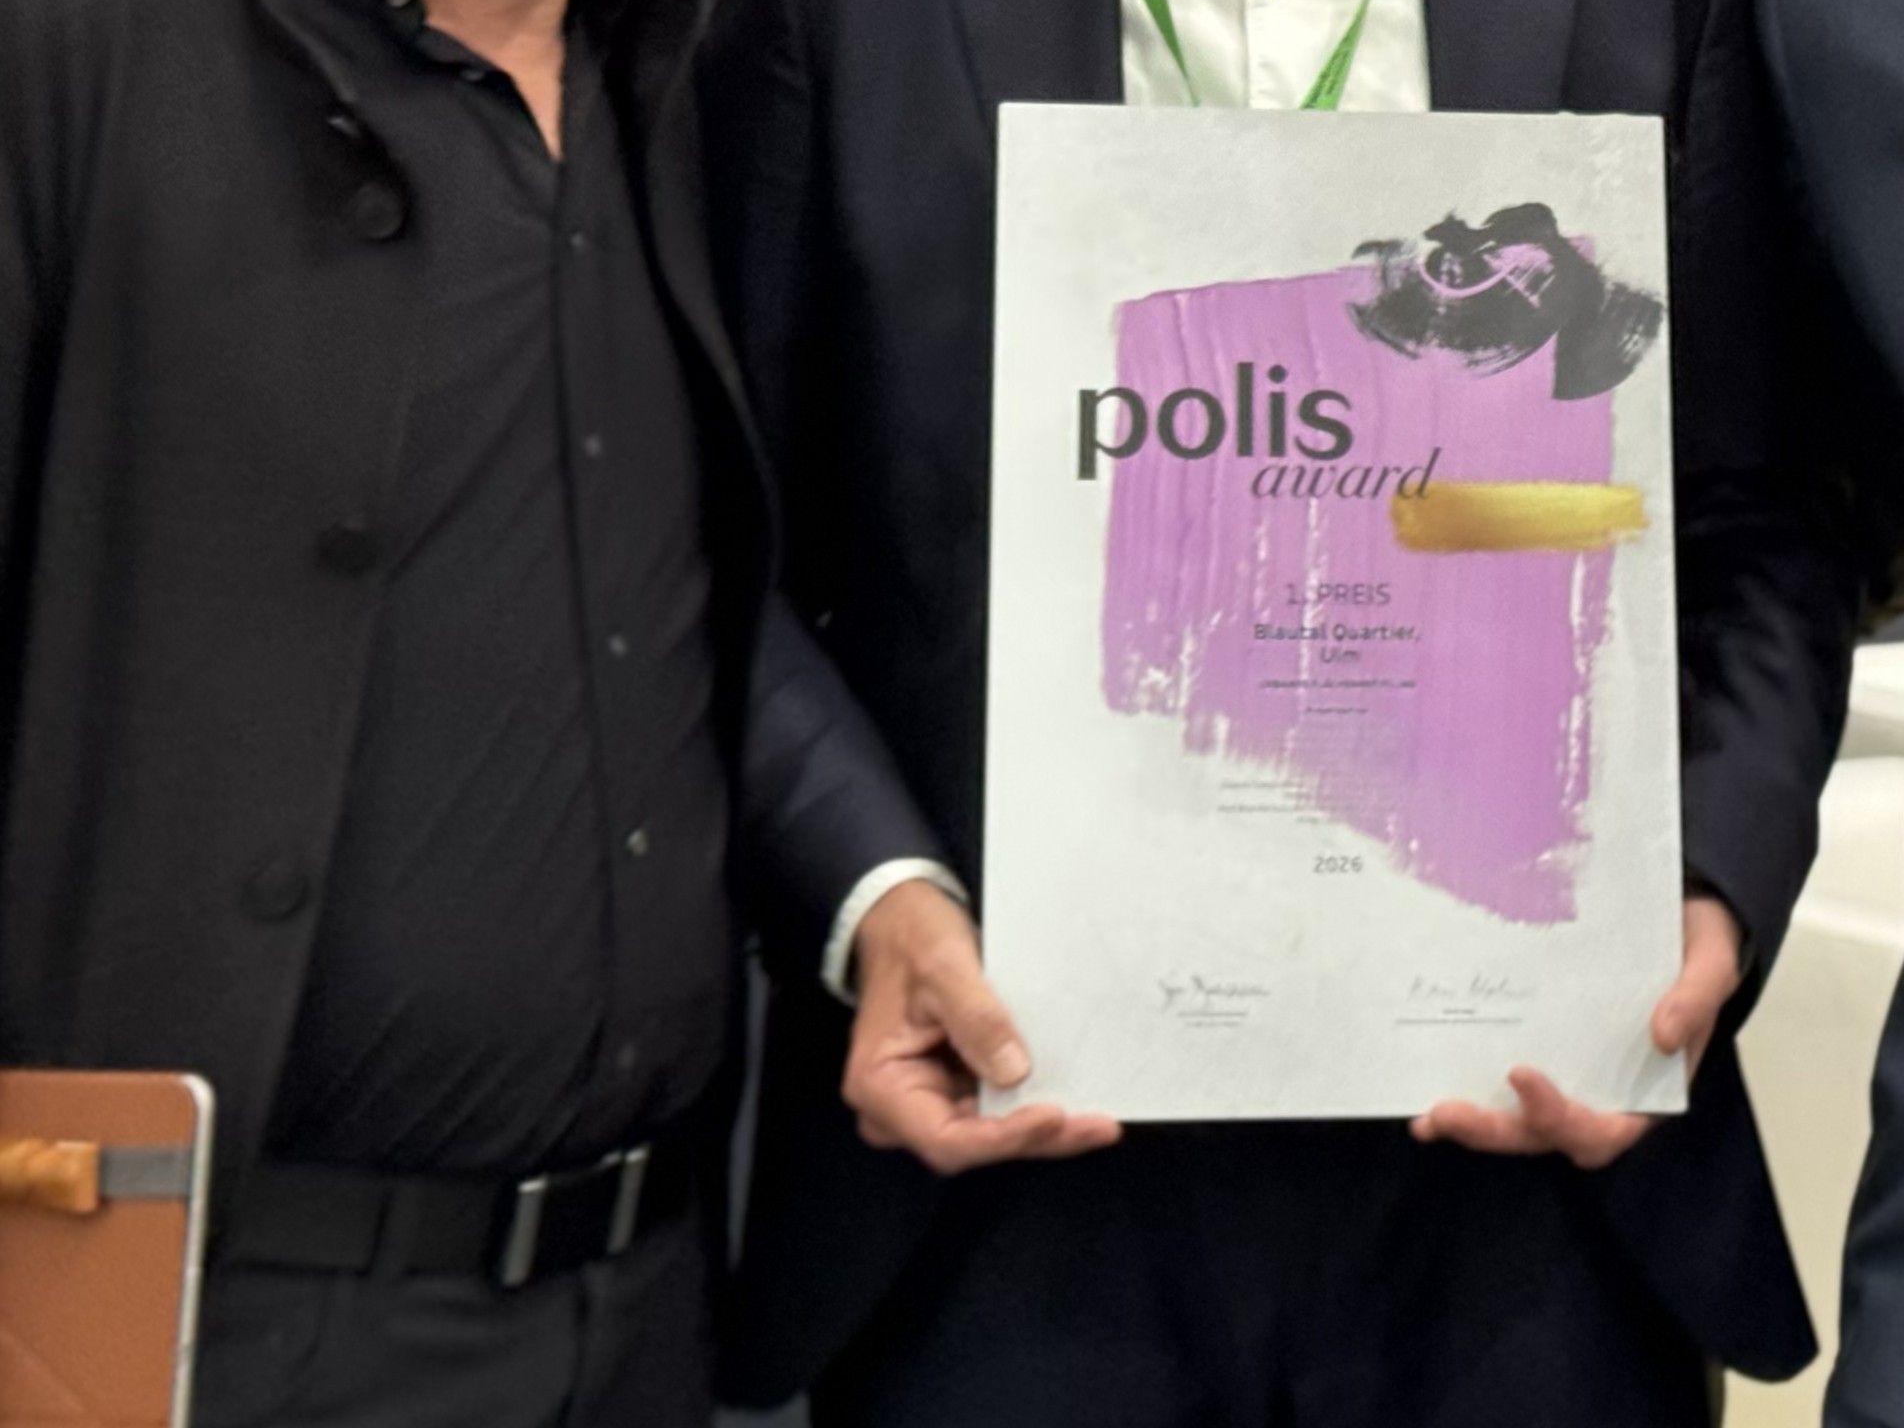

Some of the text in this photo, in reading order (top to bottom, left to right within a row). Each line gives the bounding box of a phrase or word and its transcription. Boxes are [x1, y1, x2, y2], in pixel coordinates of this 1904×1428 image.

[1078, 361, 1353, 480] polis
[1251, 447, 1442, 499] award
[1317, 582, 1391, 607] PREIS
[1313, 855, 1364, 873] 2026
